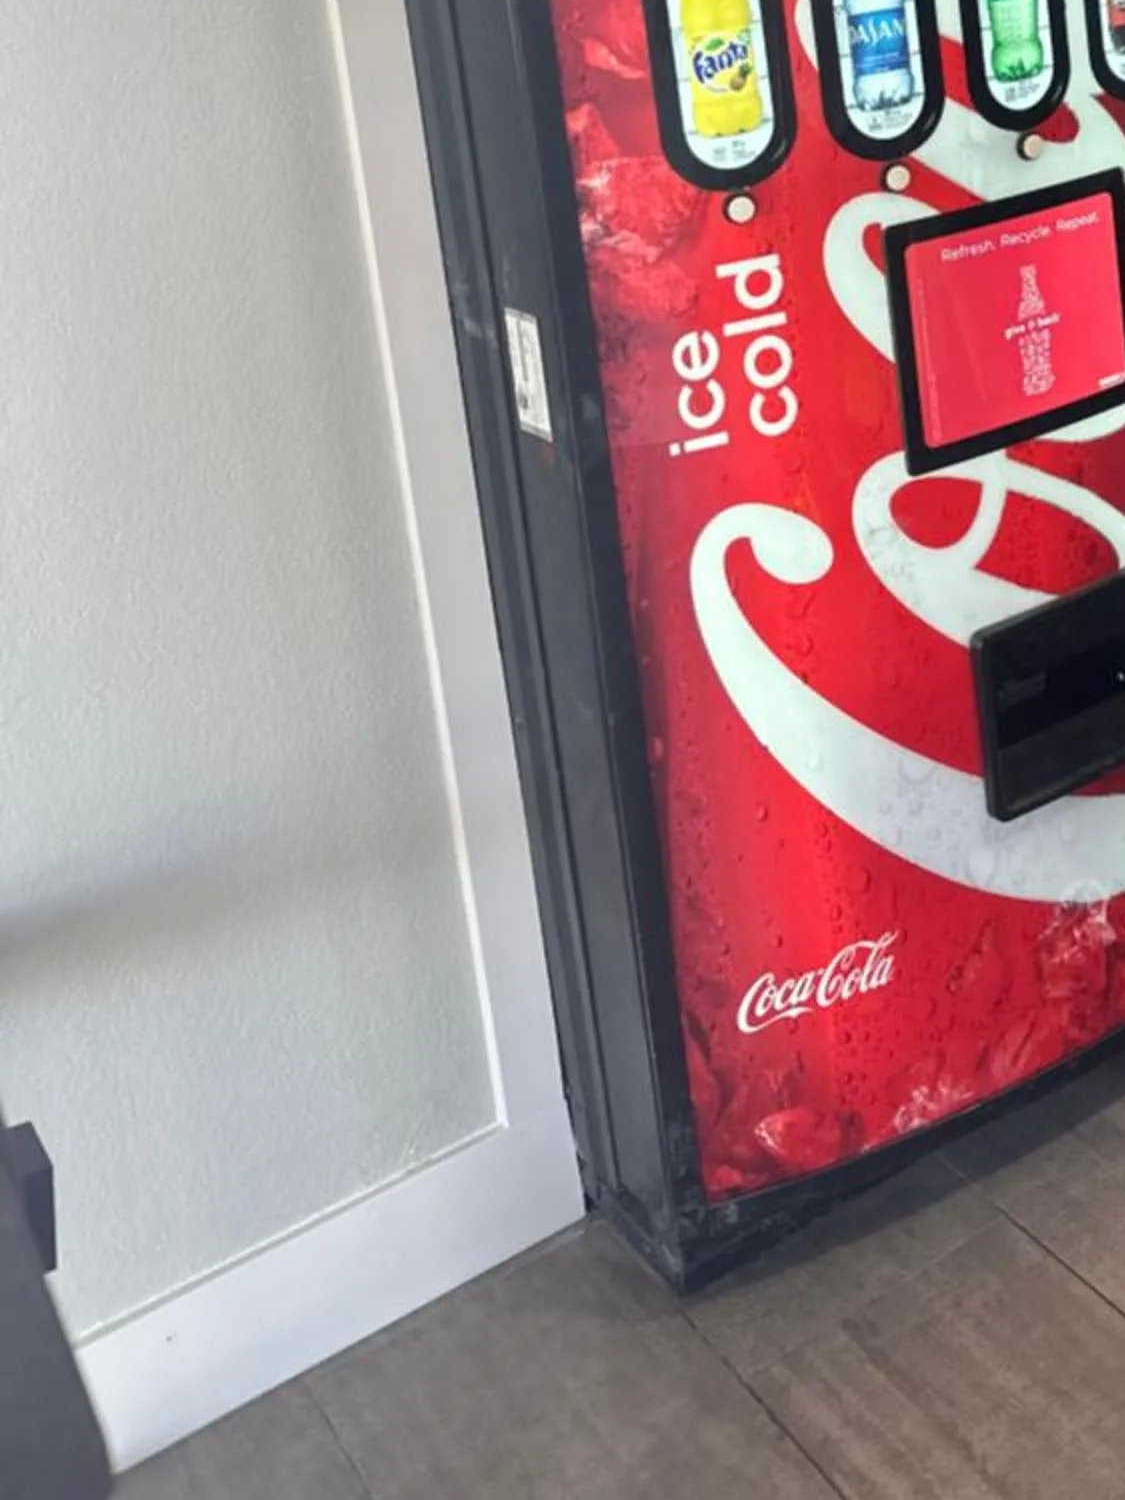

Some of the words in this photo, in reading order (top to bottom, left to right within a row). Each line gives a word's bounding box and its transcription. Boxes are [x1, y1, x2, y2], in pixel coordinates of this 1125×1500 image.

[668, 330, 730, 457] ice
[715, 253, 799, 437] cold
[736, 929, 899, 1034] Coca-Cola
